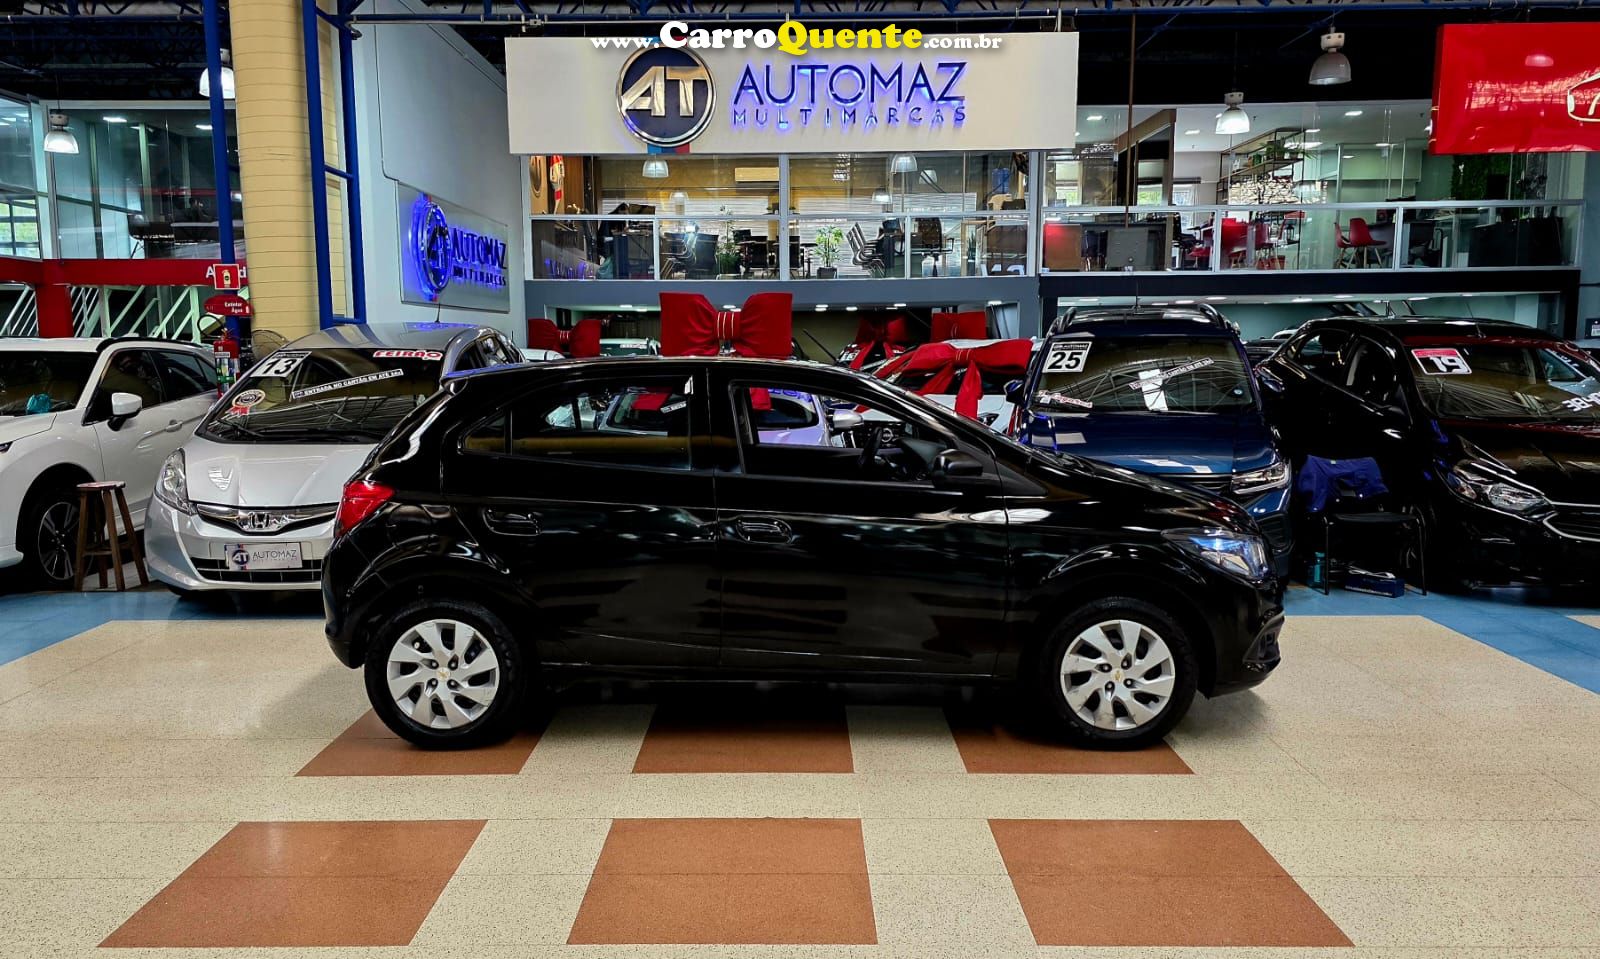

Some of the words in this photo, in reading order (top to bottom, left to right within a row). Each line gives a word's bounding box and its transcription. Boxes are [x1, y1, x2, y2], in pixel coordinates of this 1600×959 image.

[733, 62, 967, 105] AUTOMAZ
[733, 106, 967, 126] MULTIMARCAS
[451, 228, 508, 270] AUTOMAZ
[262, 359, 297, 375] 13
[1047, 351, 1083, 370] 25
[1429, 356, 1469, 374] 19
[252, 549, 297, 559] AUTOMAZ
